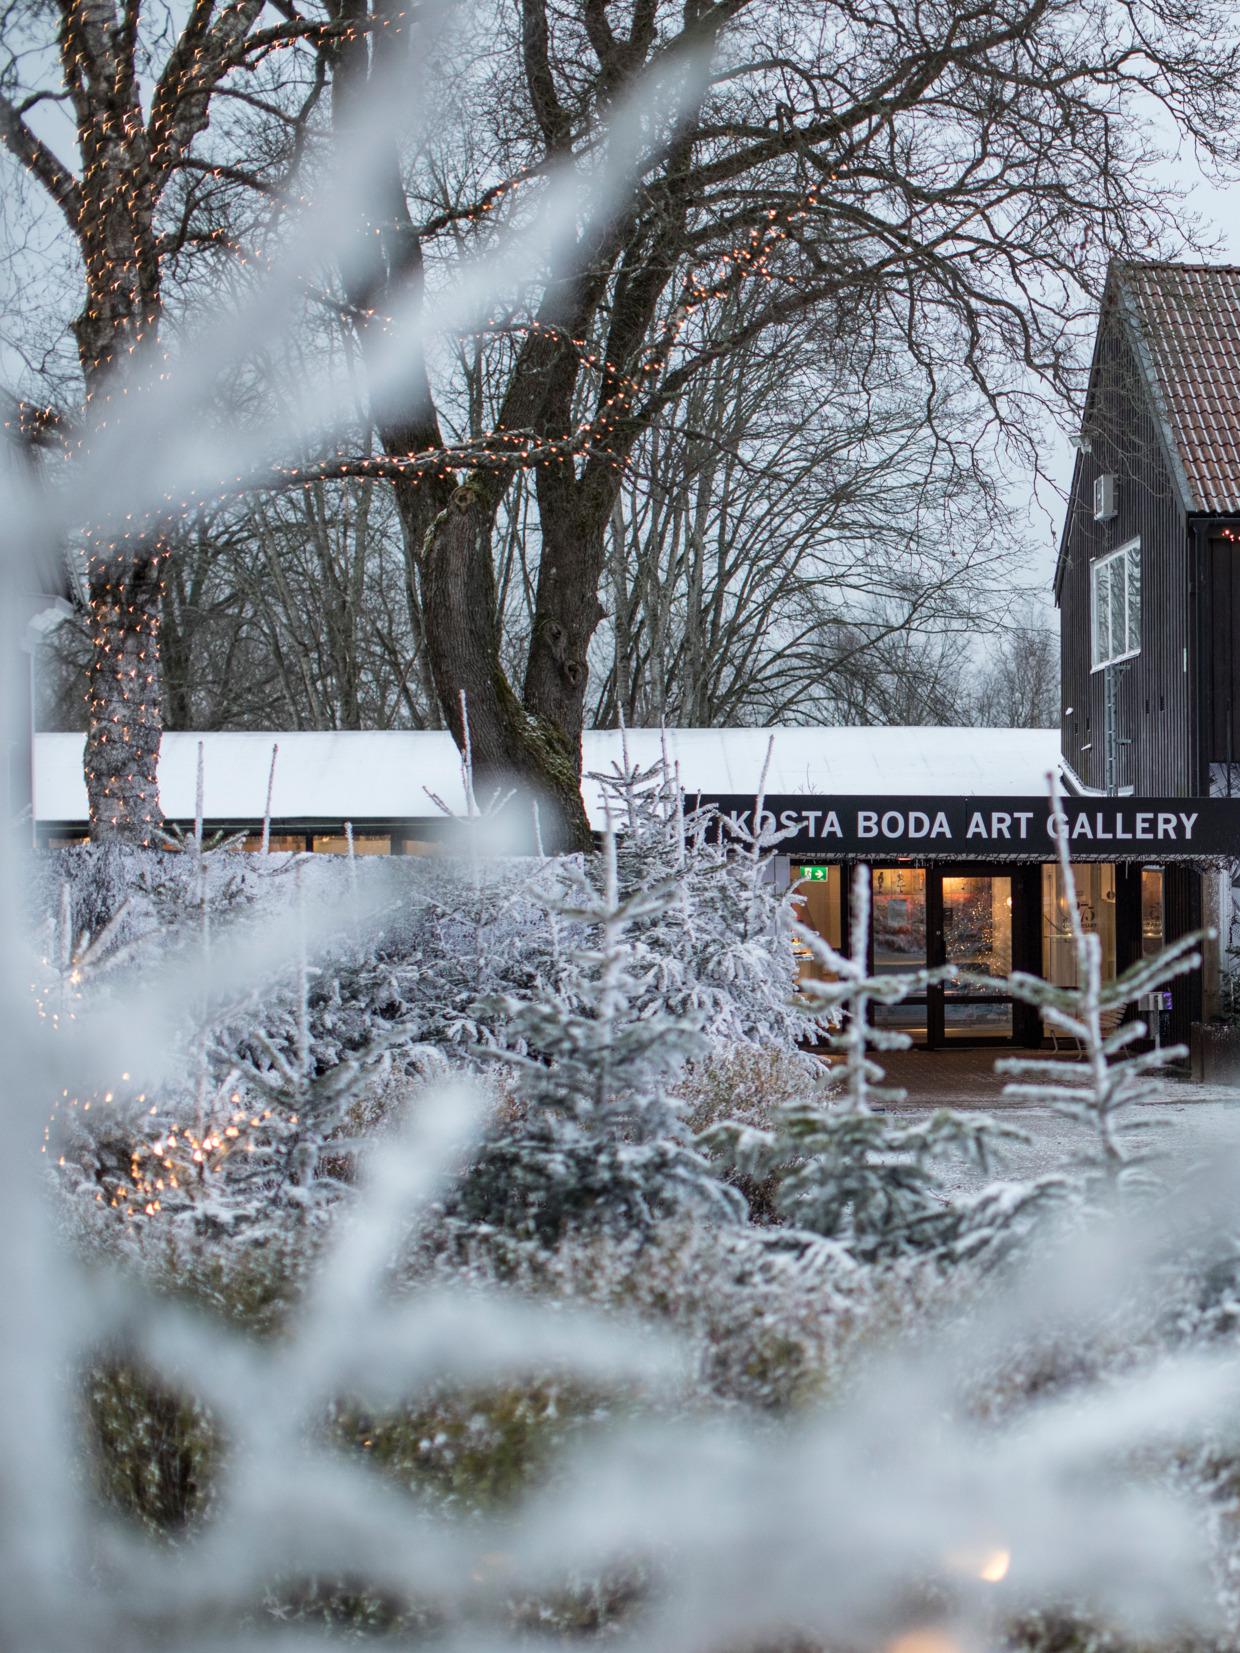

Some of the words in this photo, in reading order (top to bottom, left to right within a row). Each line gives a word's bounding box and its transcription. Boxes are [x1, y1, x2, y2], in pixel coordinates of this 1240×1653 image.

[857, 811, 952, 838] BODA
[966, 812, 1034, 838] ART
[1046, 812, 1199, 839] GALLERY
